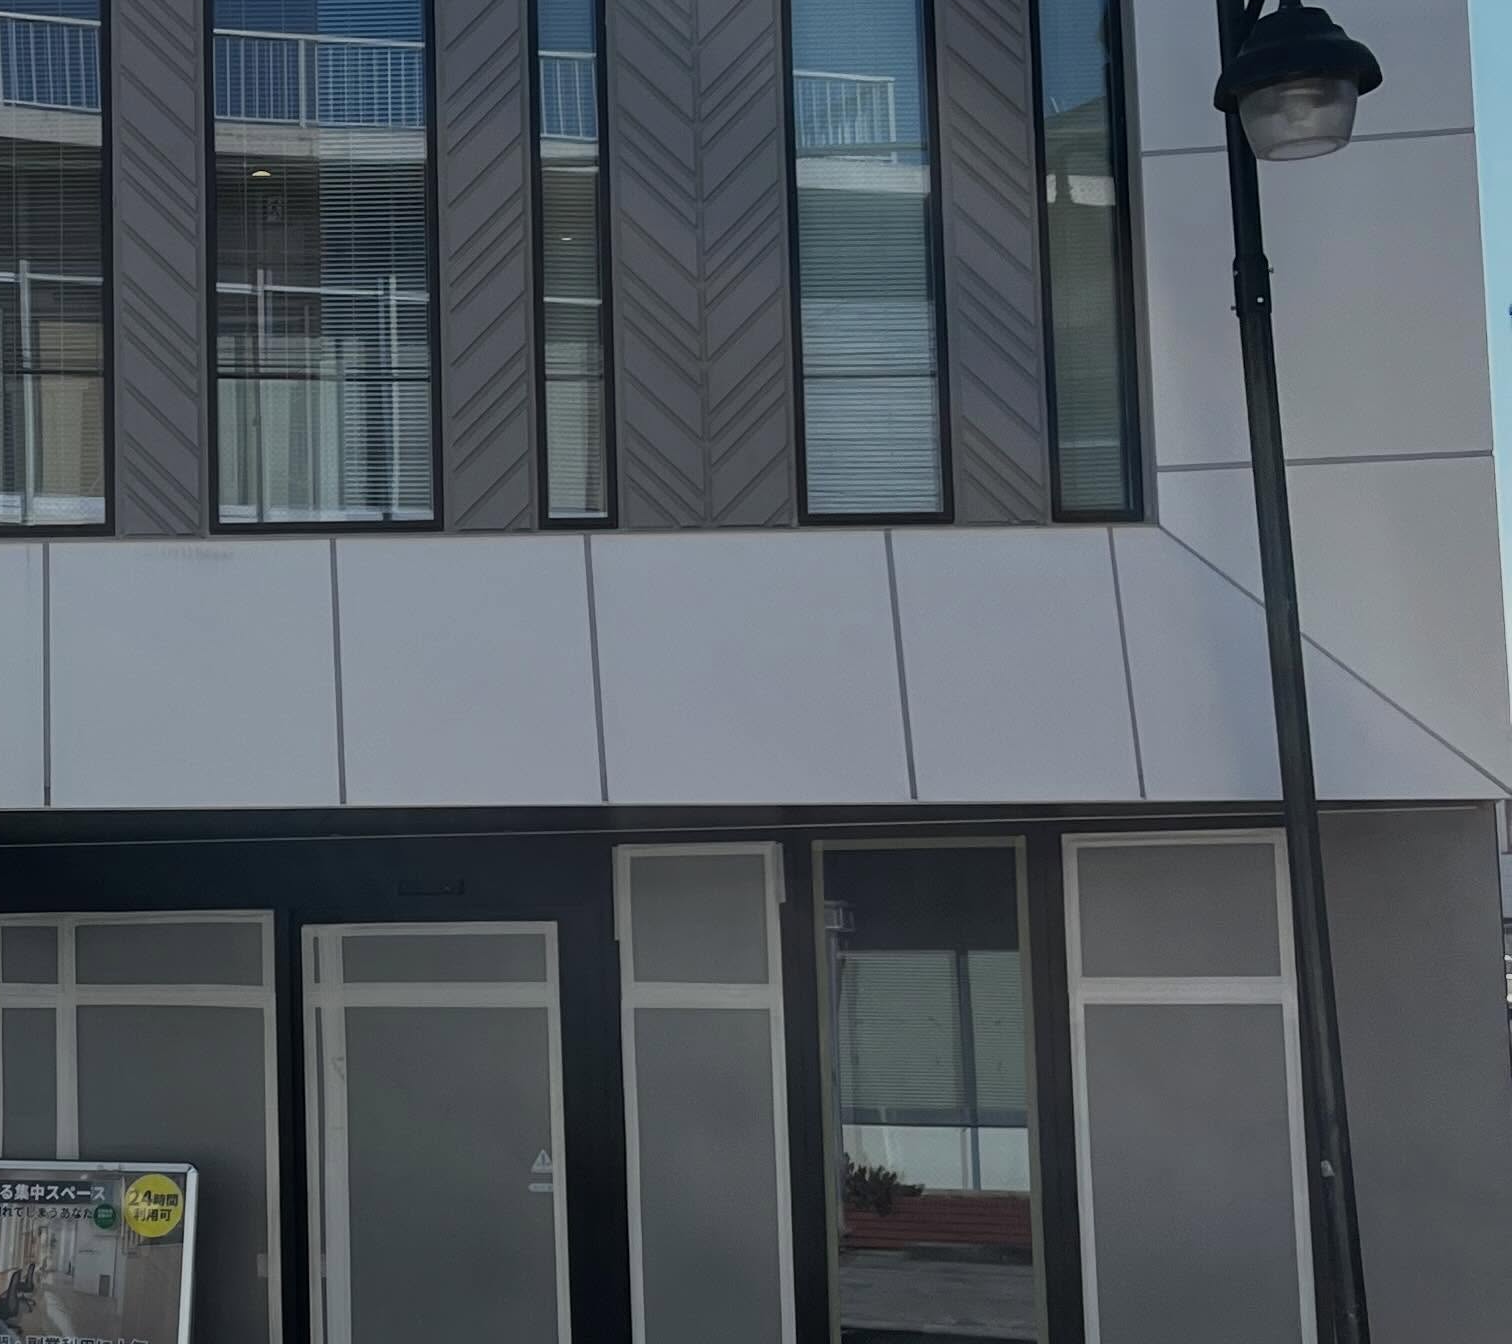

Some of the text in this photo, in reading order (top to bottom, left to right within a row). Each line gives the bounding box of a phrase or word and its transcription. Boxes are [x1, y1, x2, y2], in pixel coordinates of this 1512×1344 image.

[128, 1189, 179, 1206] 24時間
[135, 1208, 172, 1222] 利用可
